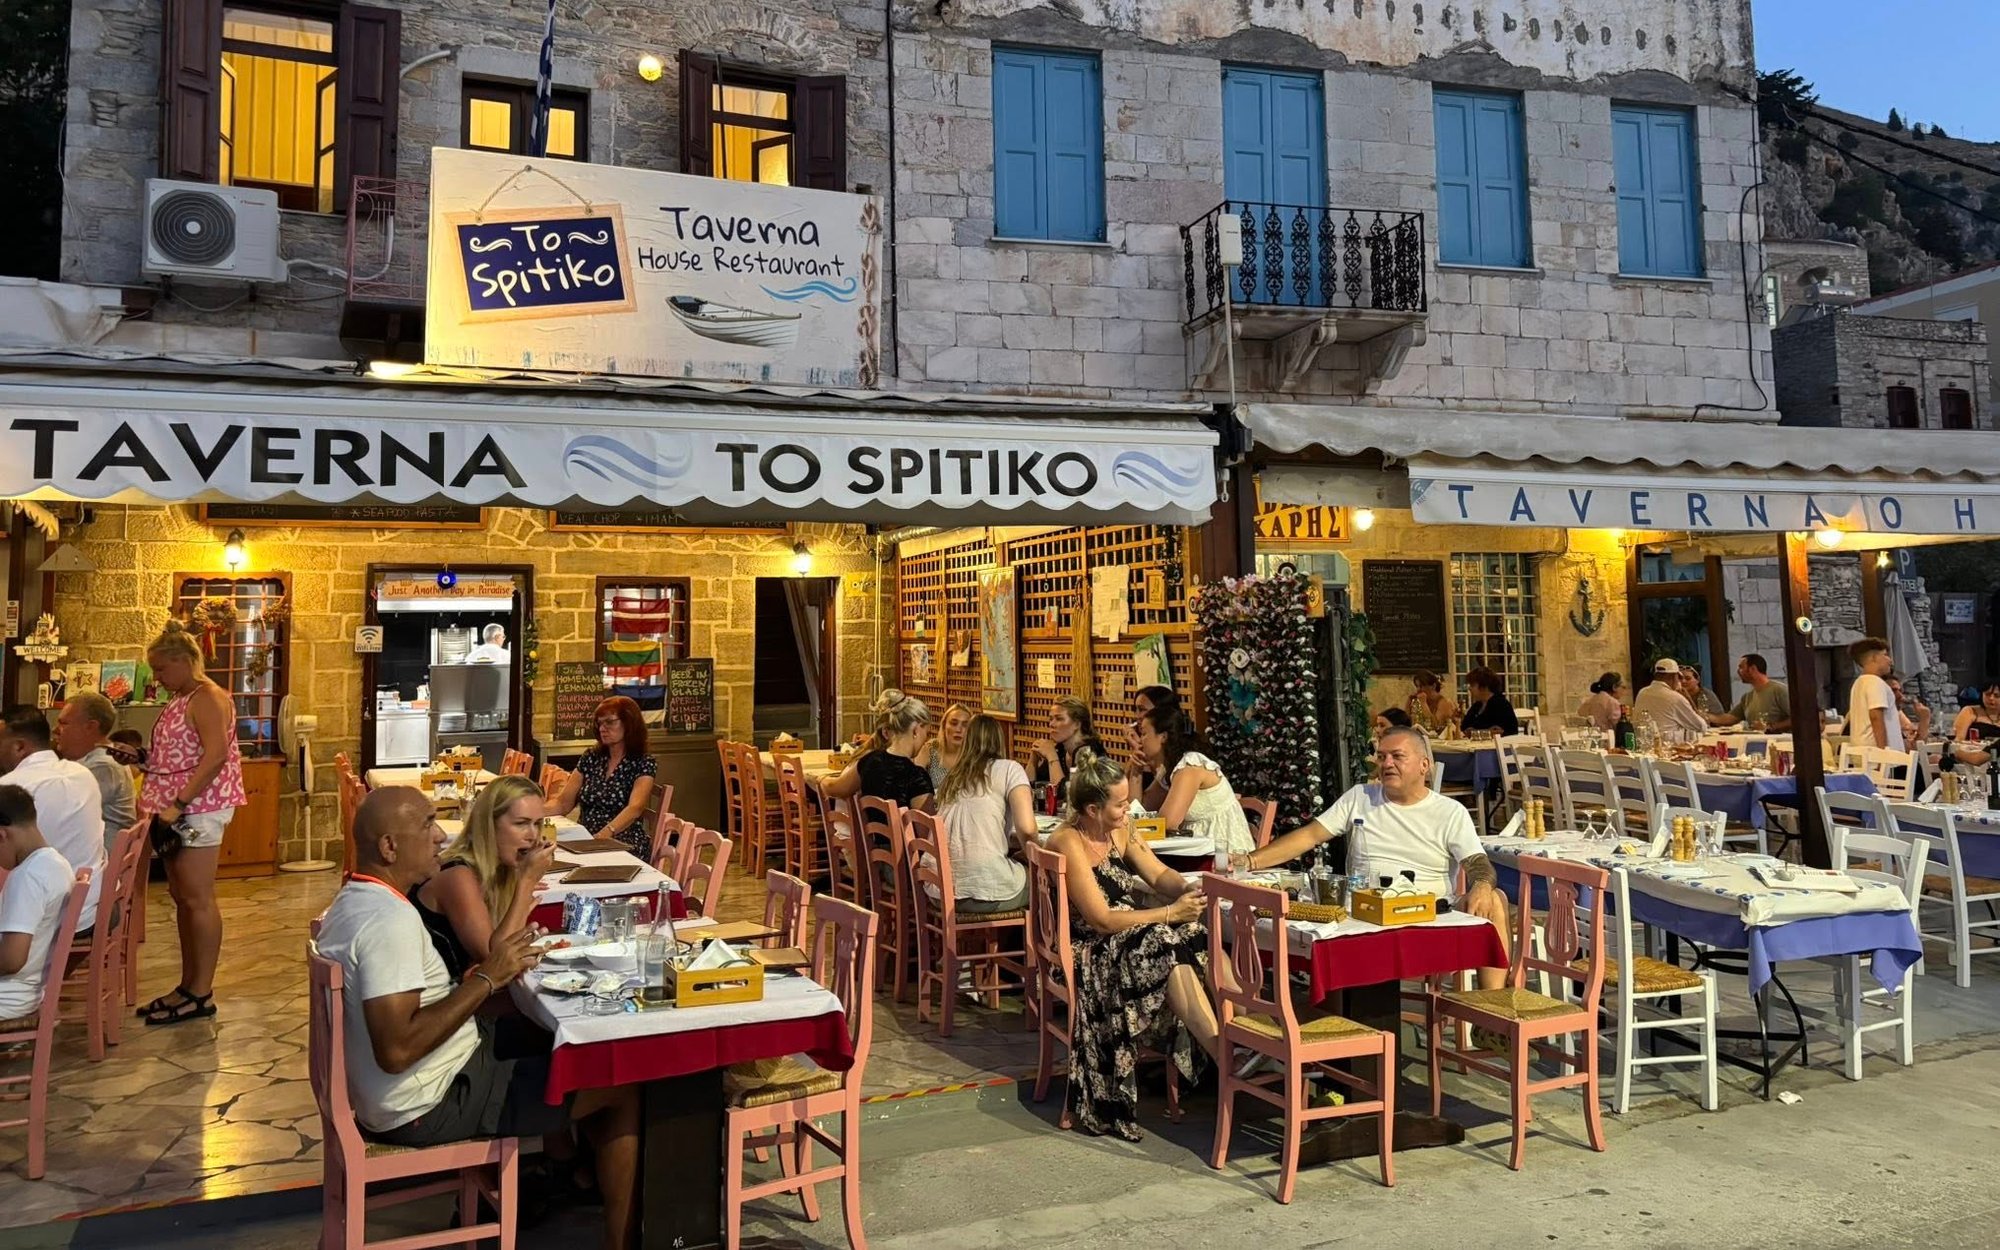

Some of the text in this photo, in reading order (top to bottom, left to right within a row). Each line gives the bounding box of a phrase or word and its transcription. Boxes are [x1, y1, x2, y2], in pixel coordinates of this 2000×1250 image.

[511, 225, 561, 252] To
[659, 207, 820, 247] Taverna
[638, 246, 845, 277] House Restaurant
[472, 253, 615, 306] Spitiko
[9, 419, 528, 488] TAVERNA
[715, 443, 1098, 496] TO SPITIKO
[1448, 483, 1829, 528] TAVERNA
[1879, 496, 1902, 529] O
[388, 585, 407, 596] Just
[413, 584, 444, 596] Another
[467, 586, 475, 595] in
[478, 585, 511, 596] Paradise
[23, 646, 61, 654] WELCOME
[558, 684, 604, 693] LEMONADE
[696, 669, 708, 679] IN
